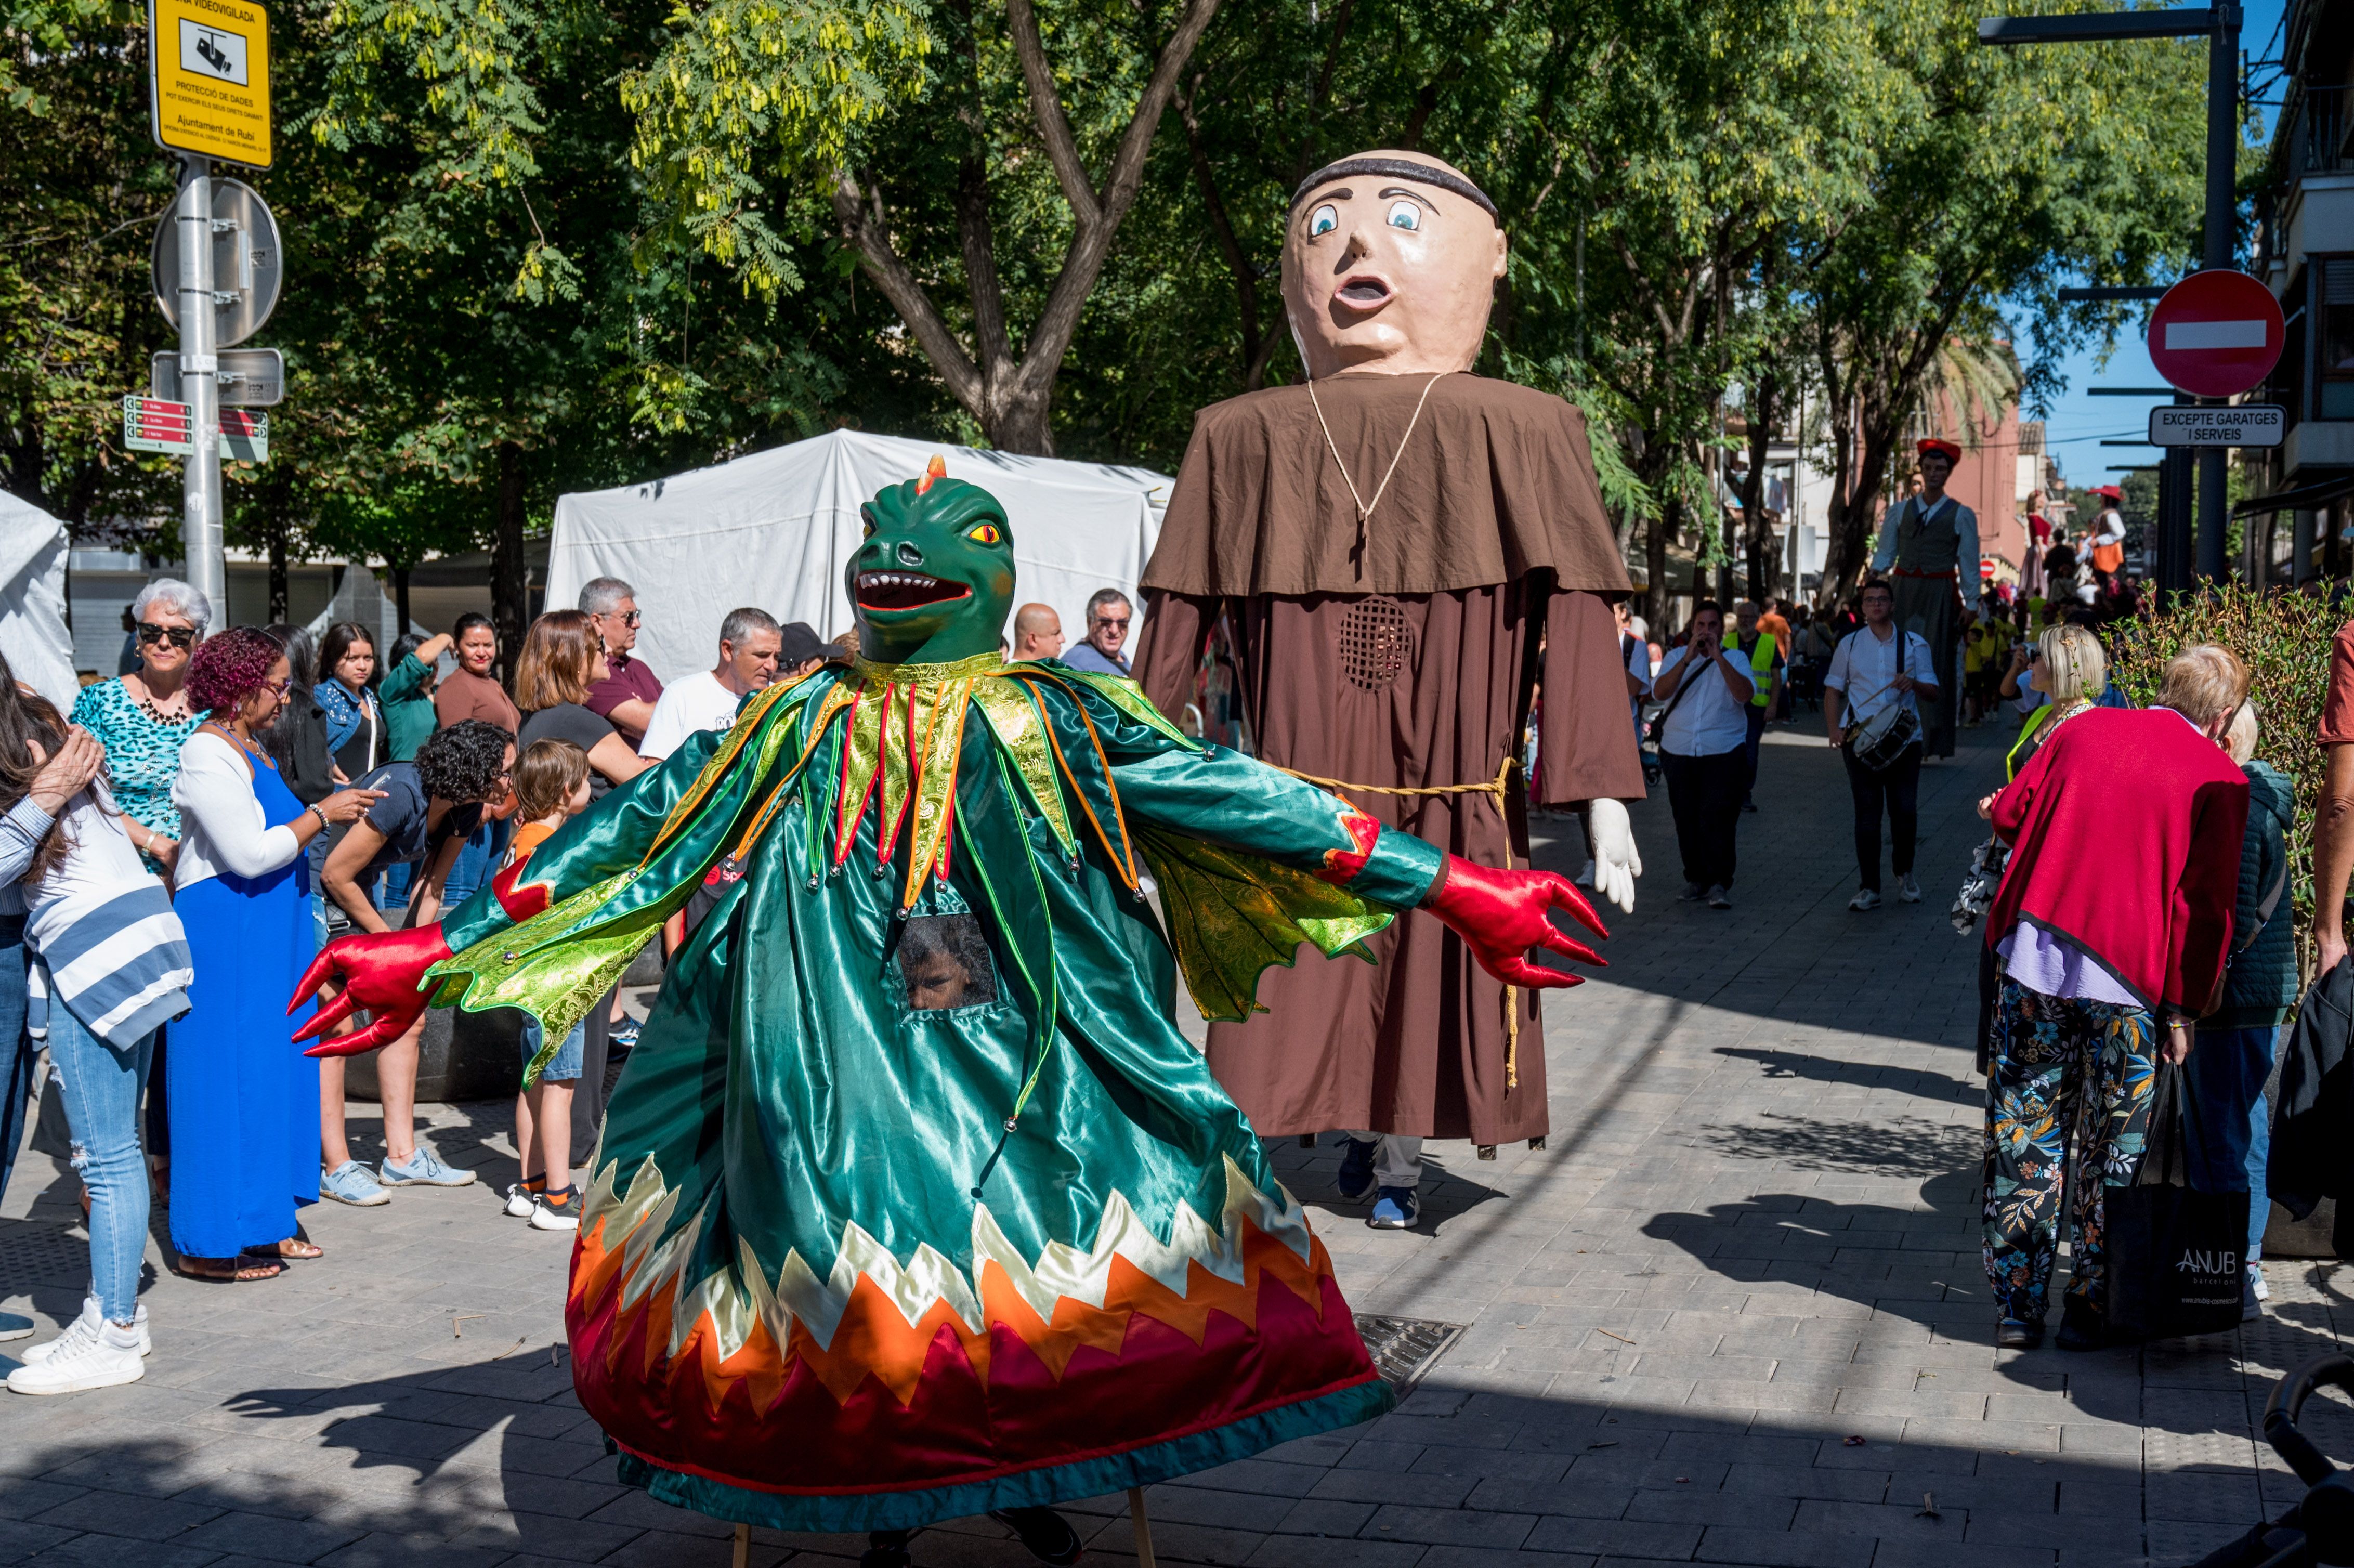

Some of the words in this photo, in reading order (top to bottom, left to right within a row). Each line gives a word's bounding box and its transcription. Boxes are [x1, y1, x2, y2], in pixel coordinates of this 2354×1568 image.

[194, 0, 255, 23] VIDEOVIGILADA
[176, 81, 217, 98] PROTECCIÓ
[219, 92, 228, 101] DE
[231, 95, 253, 107] DADES
[178, 95, 200, 106] EXERCIR
[178, 115, 223, 134] Ajuntament
[225, 127, 234, 136] de
[2163, 413, 2214, 425] EXCEPTE
[2217, 413, 2278, 425] GARATGES
[2188, 429, 2192, 440] I
[2194, 428, 2241, 440] SERVEIS
